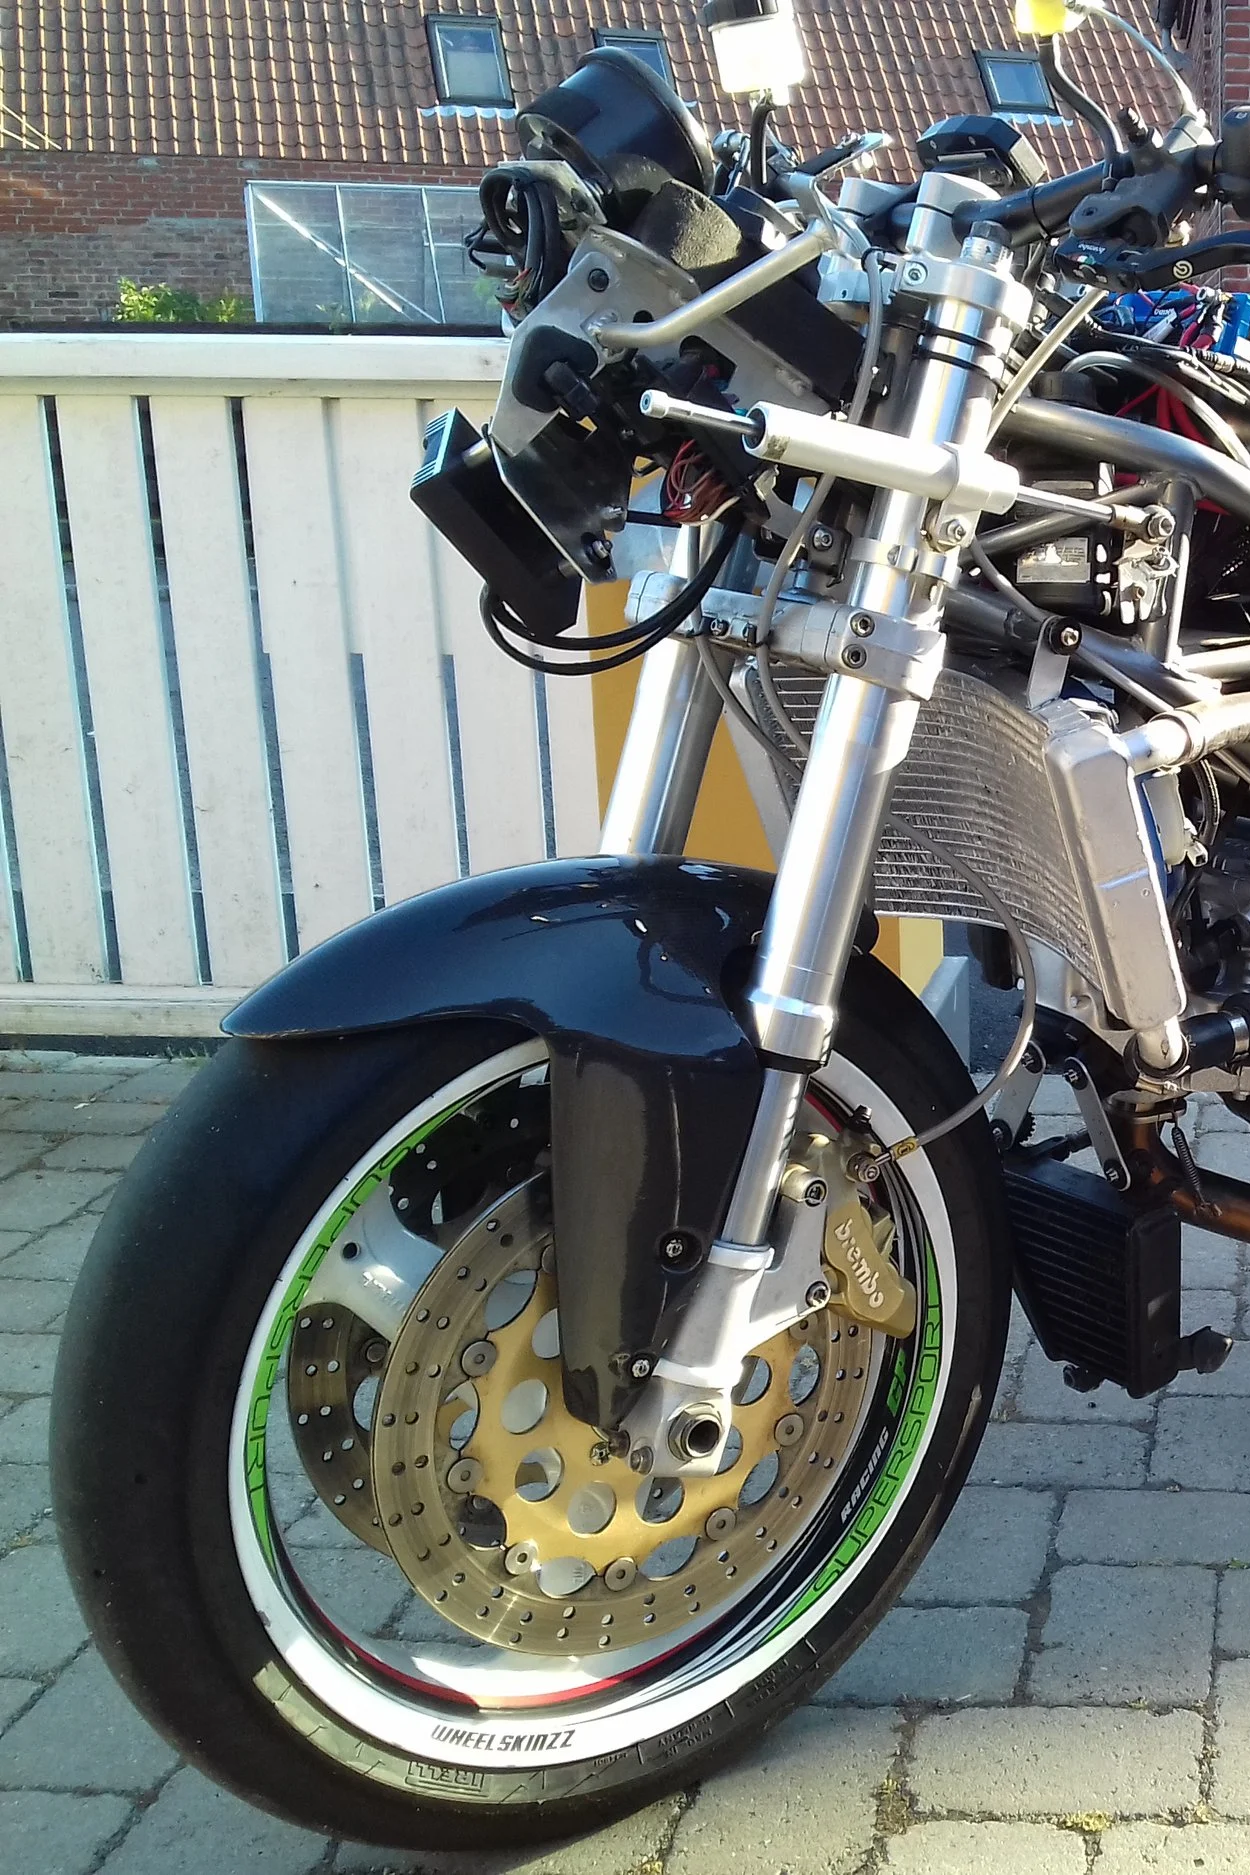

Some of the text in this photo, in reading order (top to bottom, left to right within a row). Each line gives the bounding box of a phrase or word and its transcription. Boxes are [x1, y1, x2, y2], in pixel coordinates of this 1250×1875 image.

[834, 1218, 884, 1308] brembo
[813, 1303, 942, 1593] SUPERSPORT
[840, 1424, 890, 1524] RACING
